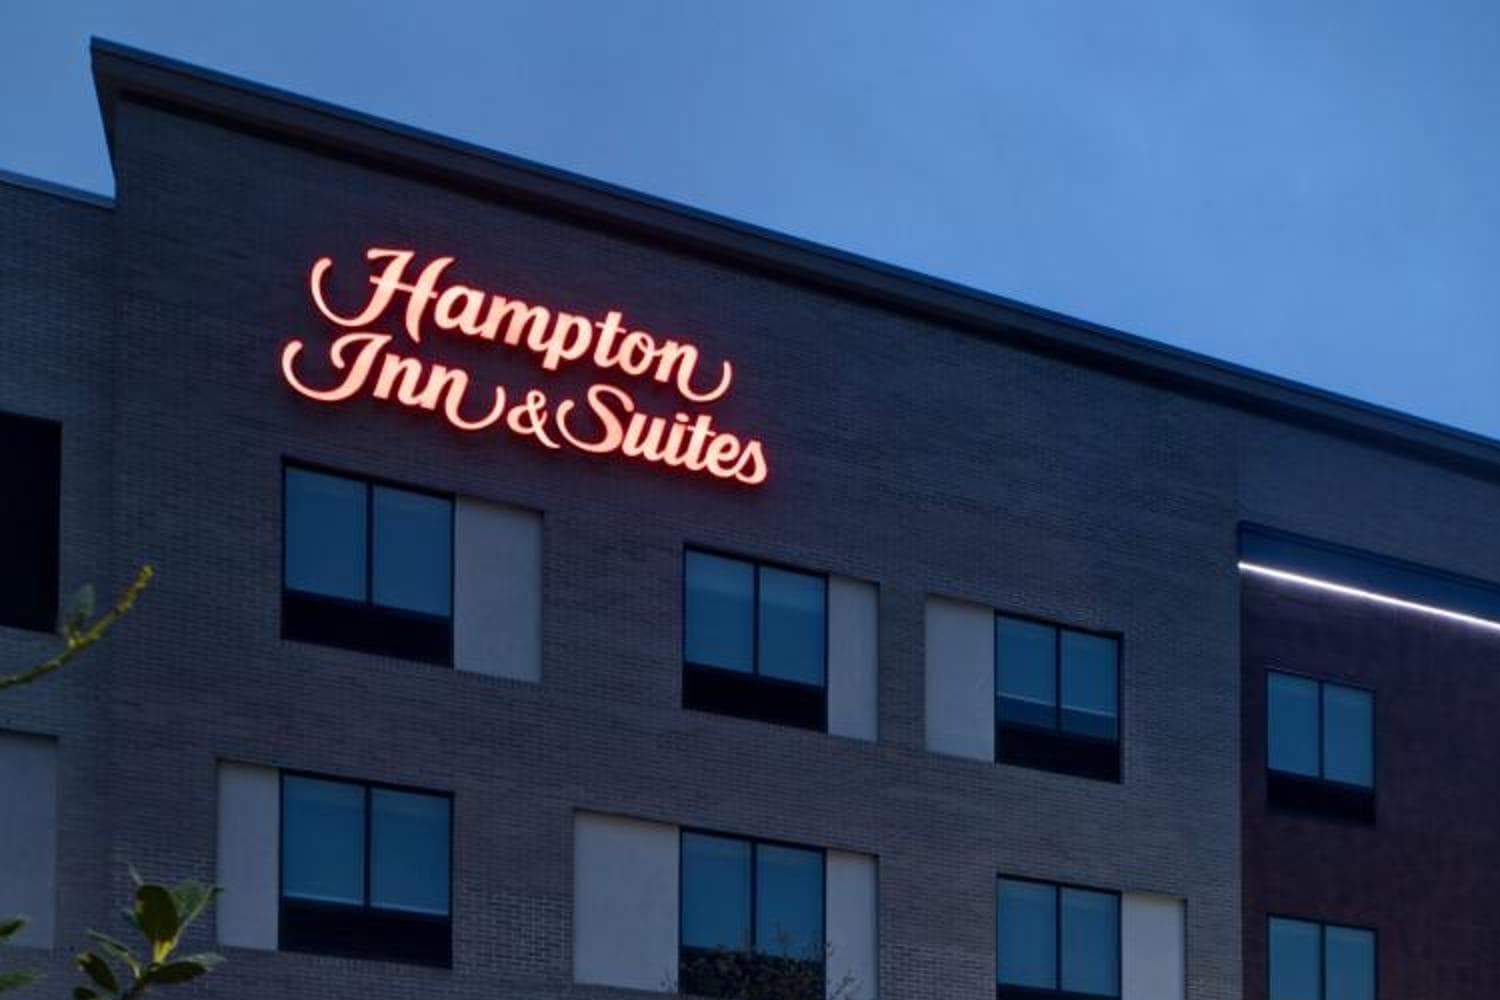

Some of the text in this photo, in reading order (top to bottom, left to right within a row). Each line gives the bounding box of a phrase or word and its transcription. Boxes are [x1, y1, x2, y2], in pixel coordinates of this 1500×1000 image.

[311, 248, 732, 402] Hampton
[282, 332, 768, 485] Inn & Suites
